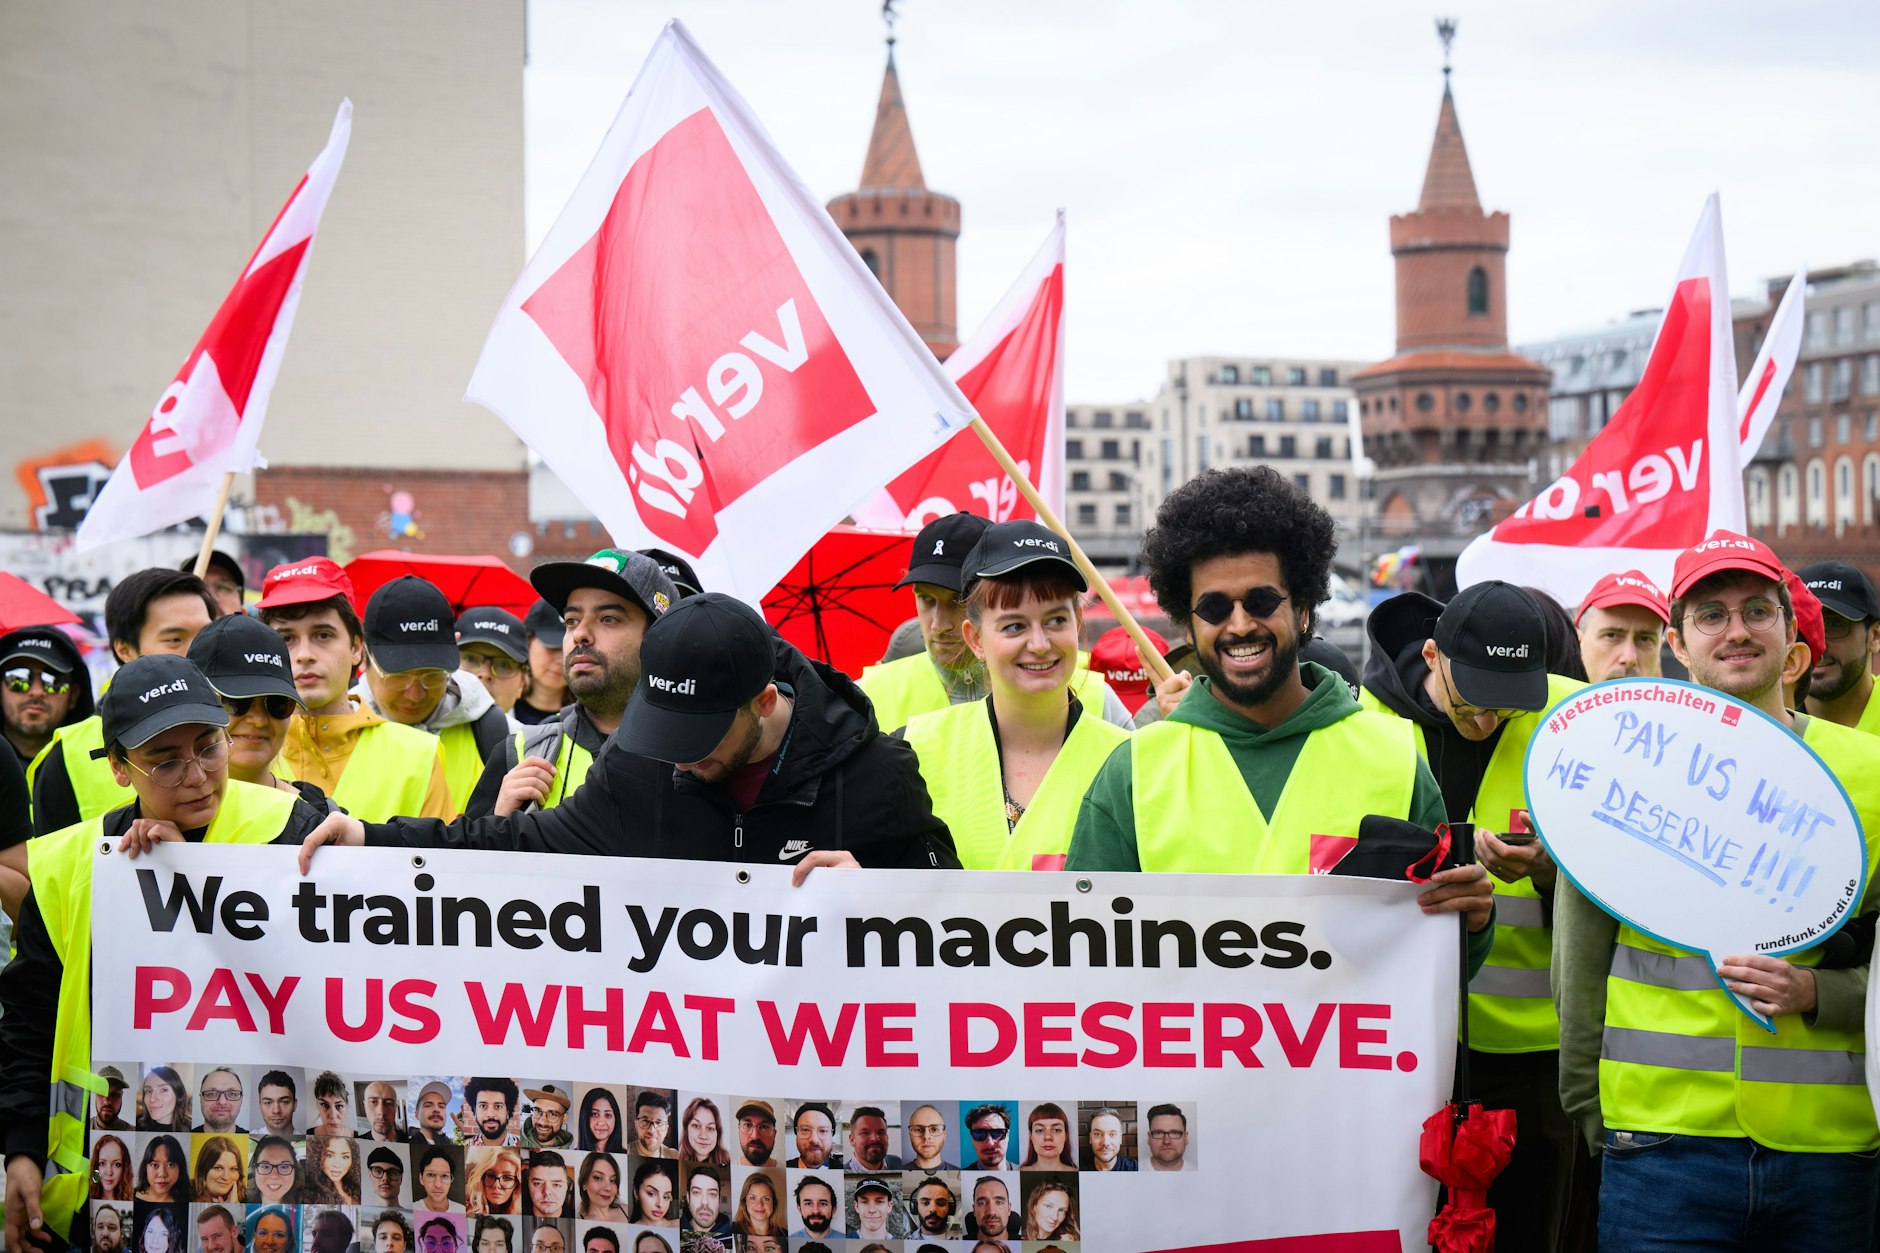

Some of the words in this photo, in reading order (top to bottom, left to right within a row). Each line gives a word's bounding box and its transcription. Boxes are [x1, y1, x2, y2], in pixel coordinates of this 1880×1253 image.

[1013, 537, 1060, 553] ver.di
[1694, 539, 1756, 554] ver.di
[272, 565, 318, 581] ver.di
[658, 564, 680, 576] r.di
[1615, 577, 1659, 598] ver.di
[399, 619, 439, 632] ver.di
[473, 621, 510, 635] ver.di
[1486, 644, 1529, 658] ver.di
[243, 653, 283, 668] ver.di
[138, 678, 189, 704] ver.di
[648, 674, 696, 696] ver.di
[1549, 685, 1716, 734] #jetzteinschalten
[1547, 748, 1596, 790] WE
[1613, 710, 1679, 767] PAY
[1687, 742, 1738, 801] US
[1745, 778, 1837, 842] WHAT
[784, 839, 810, 851] NIKE
[134, 867, 270, 941] We
[291, 873, 602, 953] trained
[624, 904, 818, 974] your
[845, 896, 1333, 970] machines.
[1754, 878, 1858, 951] rundfunk.verdi.de
[133, 965, 301, 1035] PAY
[324, 976, 441, 1045] US
[463, 980, 736, 1062] WHAT
[756, 999, 919, 1068] WE
[948, 1000, 1419, 1073] DESERVE.
